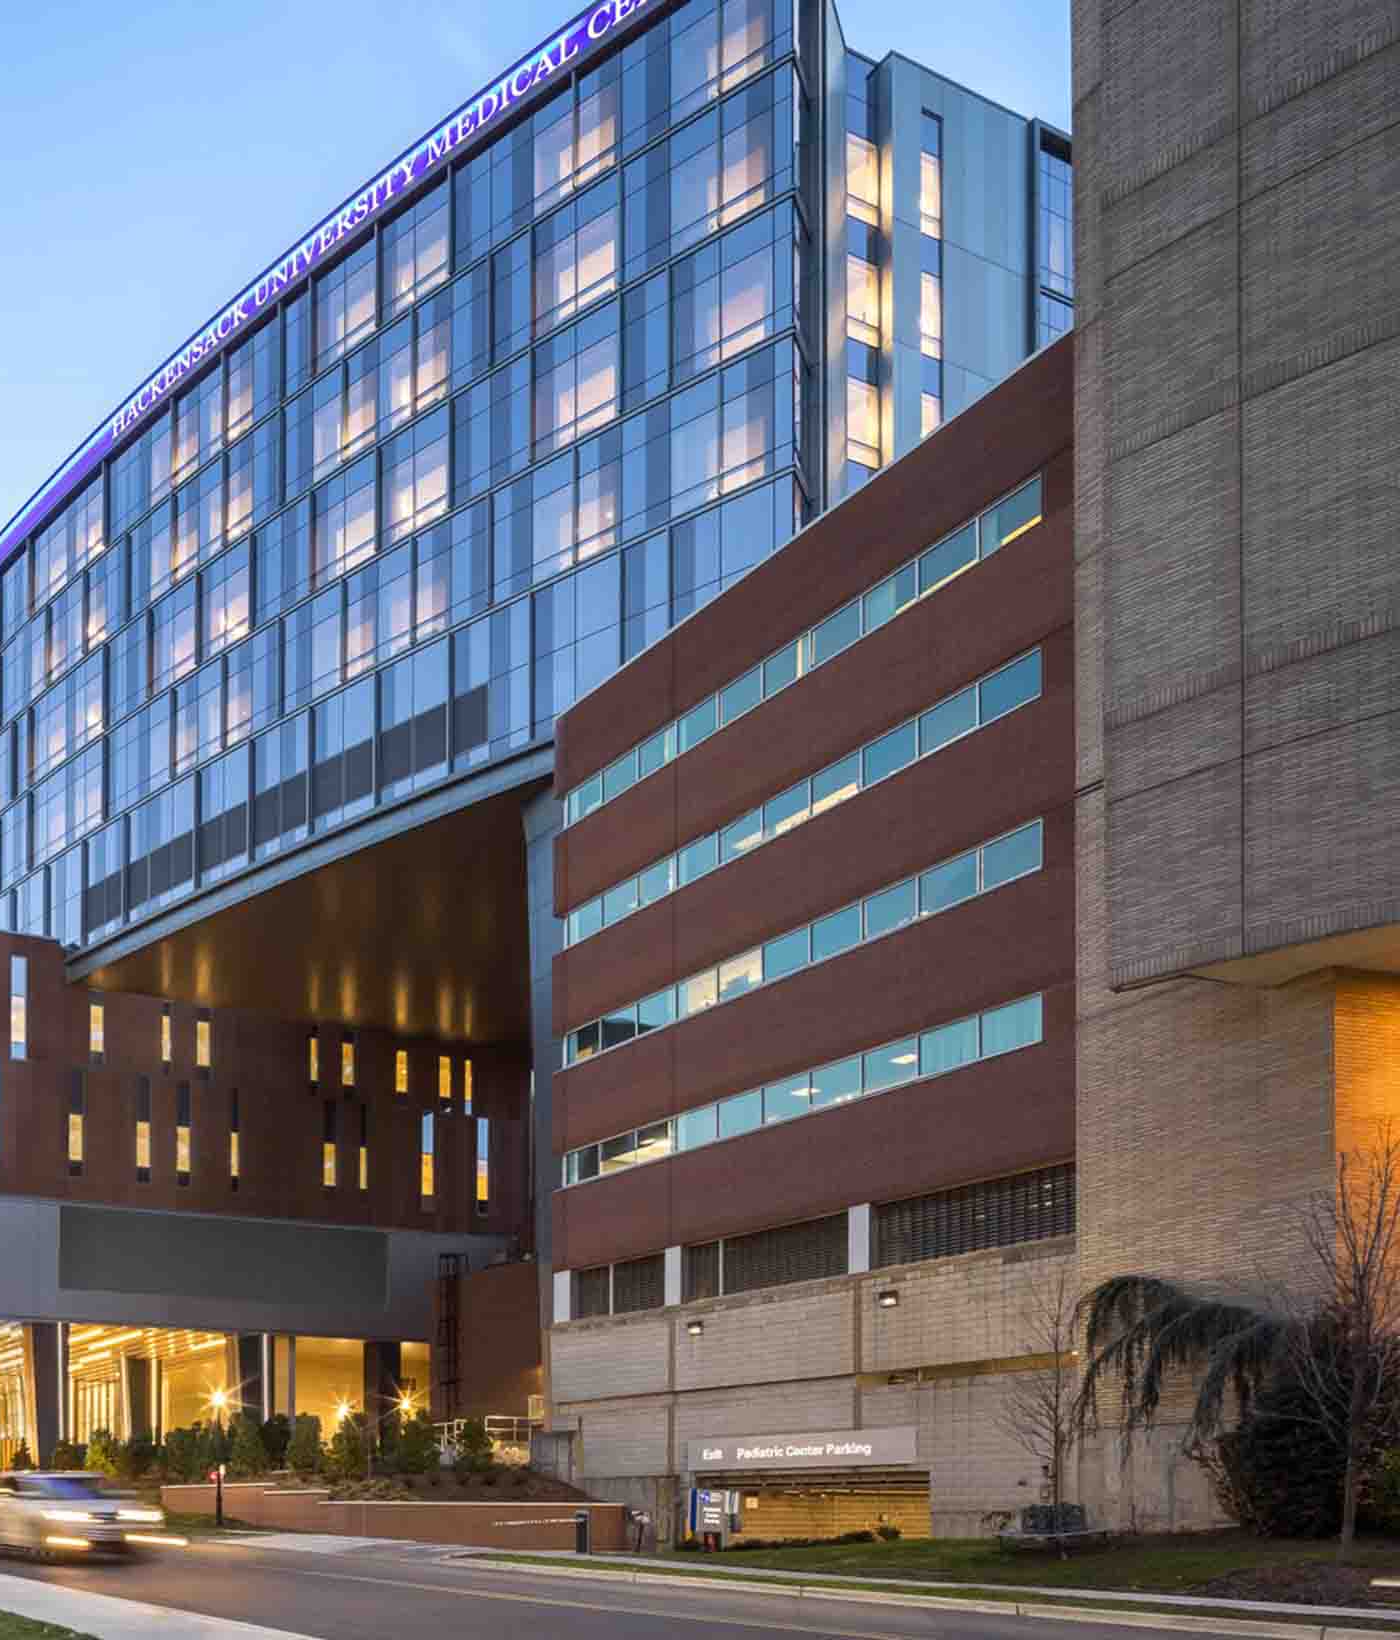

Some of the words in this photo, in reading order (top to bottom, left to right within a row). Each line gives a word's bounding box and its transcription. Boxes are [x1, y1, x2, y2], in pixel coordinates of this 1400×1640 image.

[110, 304, 248, 437] HACKENSACK
[254, 156, 418, 306] UNIVERSITY
[424, 35, 578, 168] MEDICAL
[587, 0, 648, 39] CE
[737, 1447, 784, 1460] Pediatric
[786, 1444, 824, 1457] Center
[826, 1441, 872, 1456] Parking
